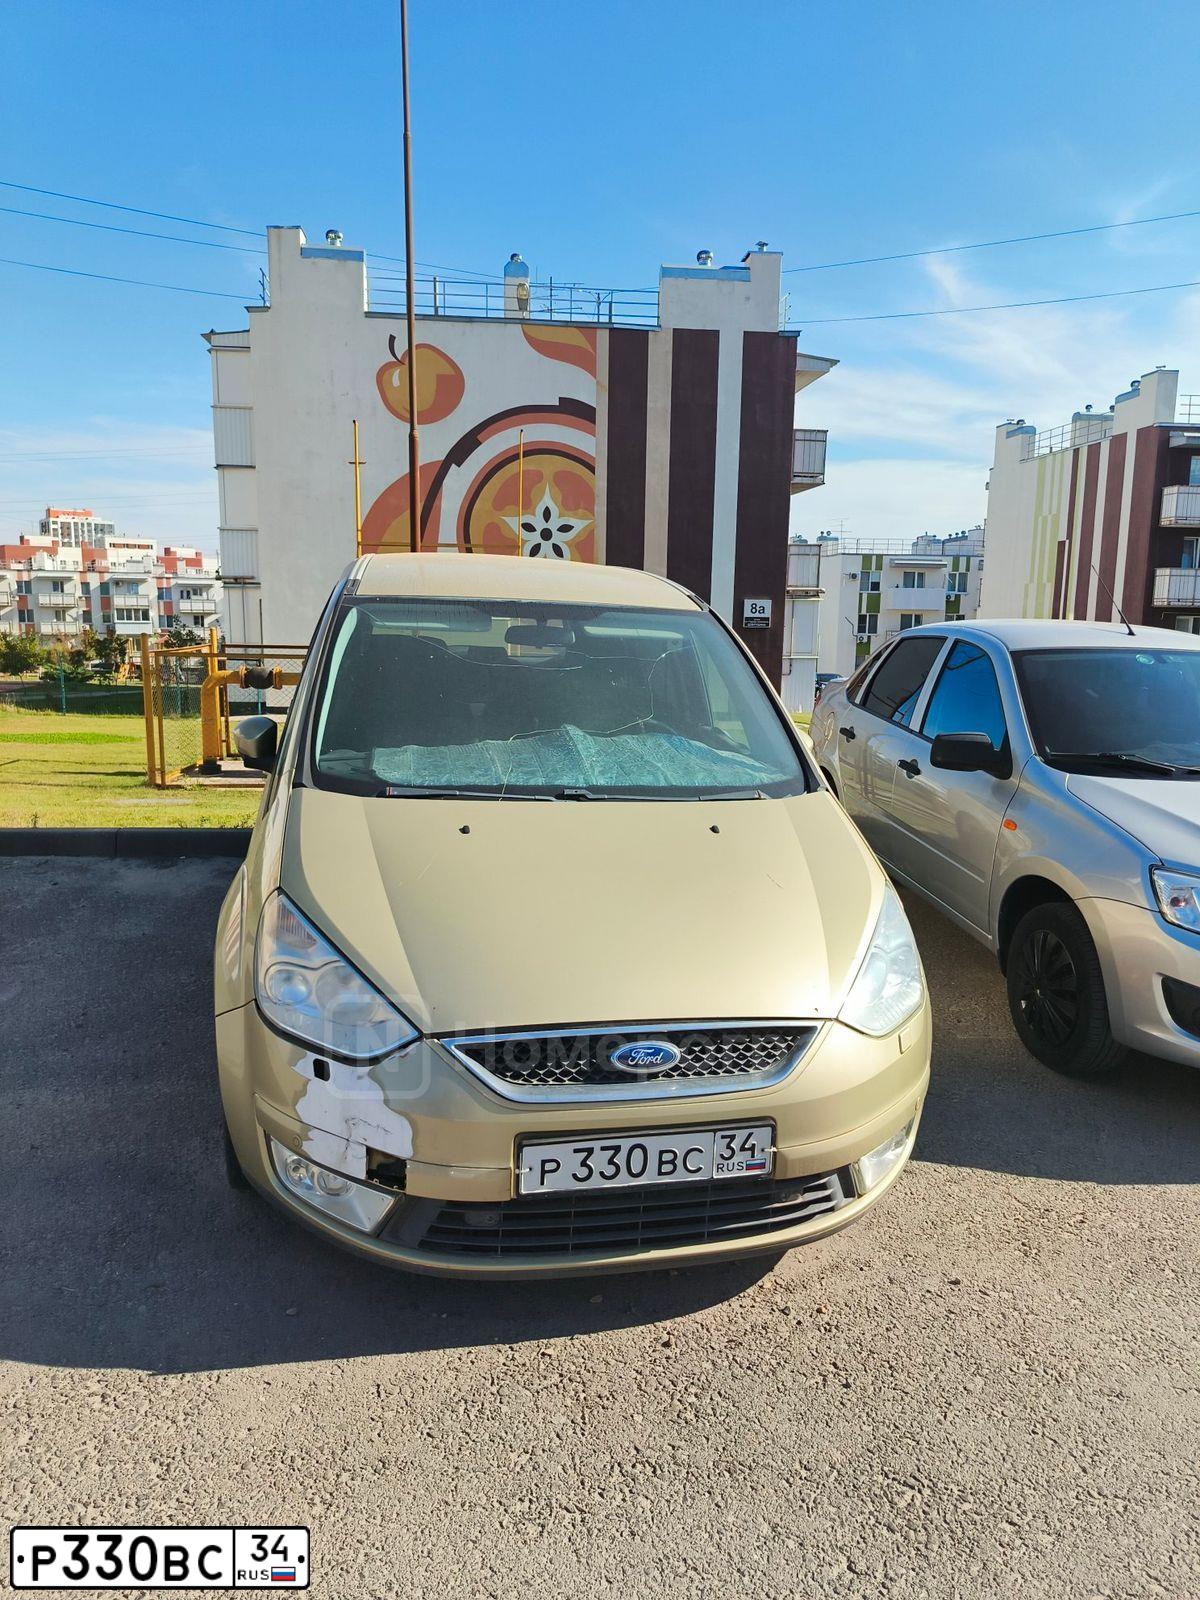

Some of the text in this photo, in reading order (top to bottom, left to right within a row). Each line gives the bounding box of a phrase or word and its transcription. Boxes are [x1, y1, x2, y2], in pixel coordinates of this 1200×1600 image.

[750, 603, 765, 614] 8а
[628, 1048, 664, 1065] Ford
[719, 1132, 756, 1160] 34
[716, 1161, 744, 1173] RUS
